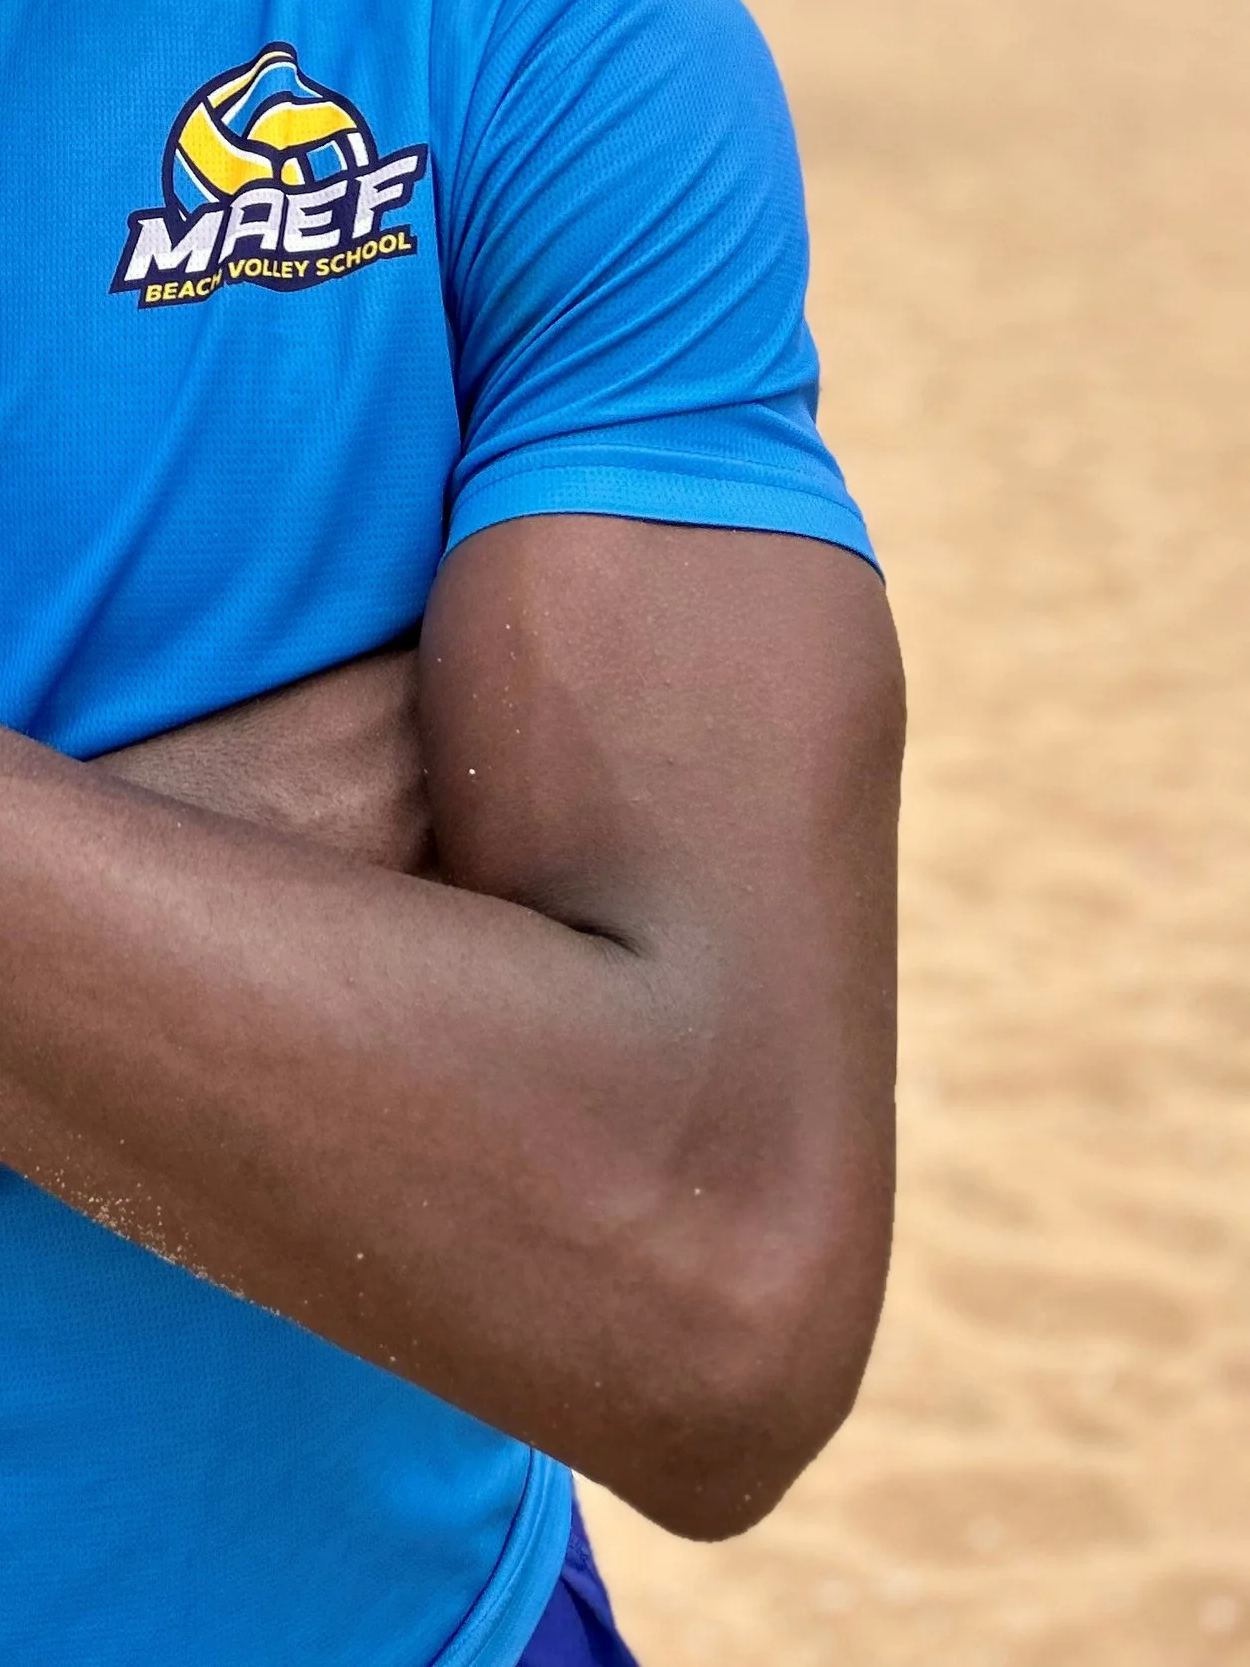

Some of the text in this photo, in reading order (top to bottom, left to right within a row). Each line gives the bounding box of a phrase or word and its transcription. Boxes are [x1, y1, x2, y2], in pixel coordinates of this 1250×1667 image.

[123, 155, 418, 282] MAEF
[144, 231, 412, 303] BEACH VOLLEY SCHOOL
